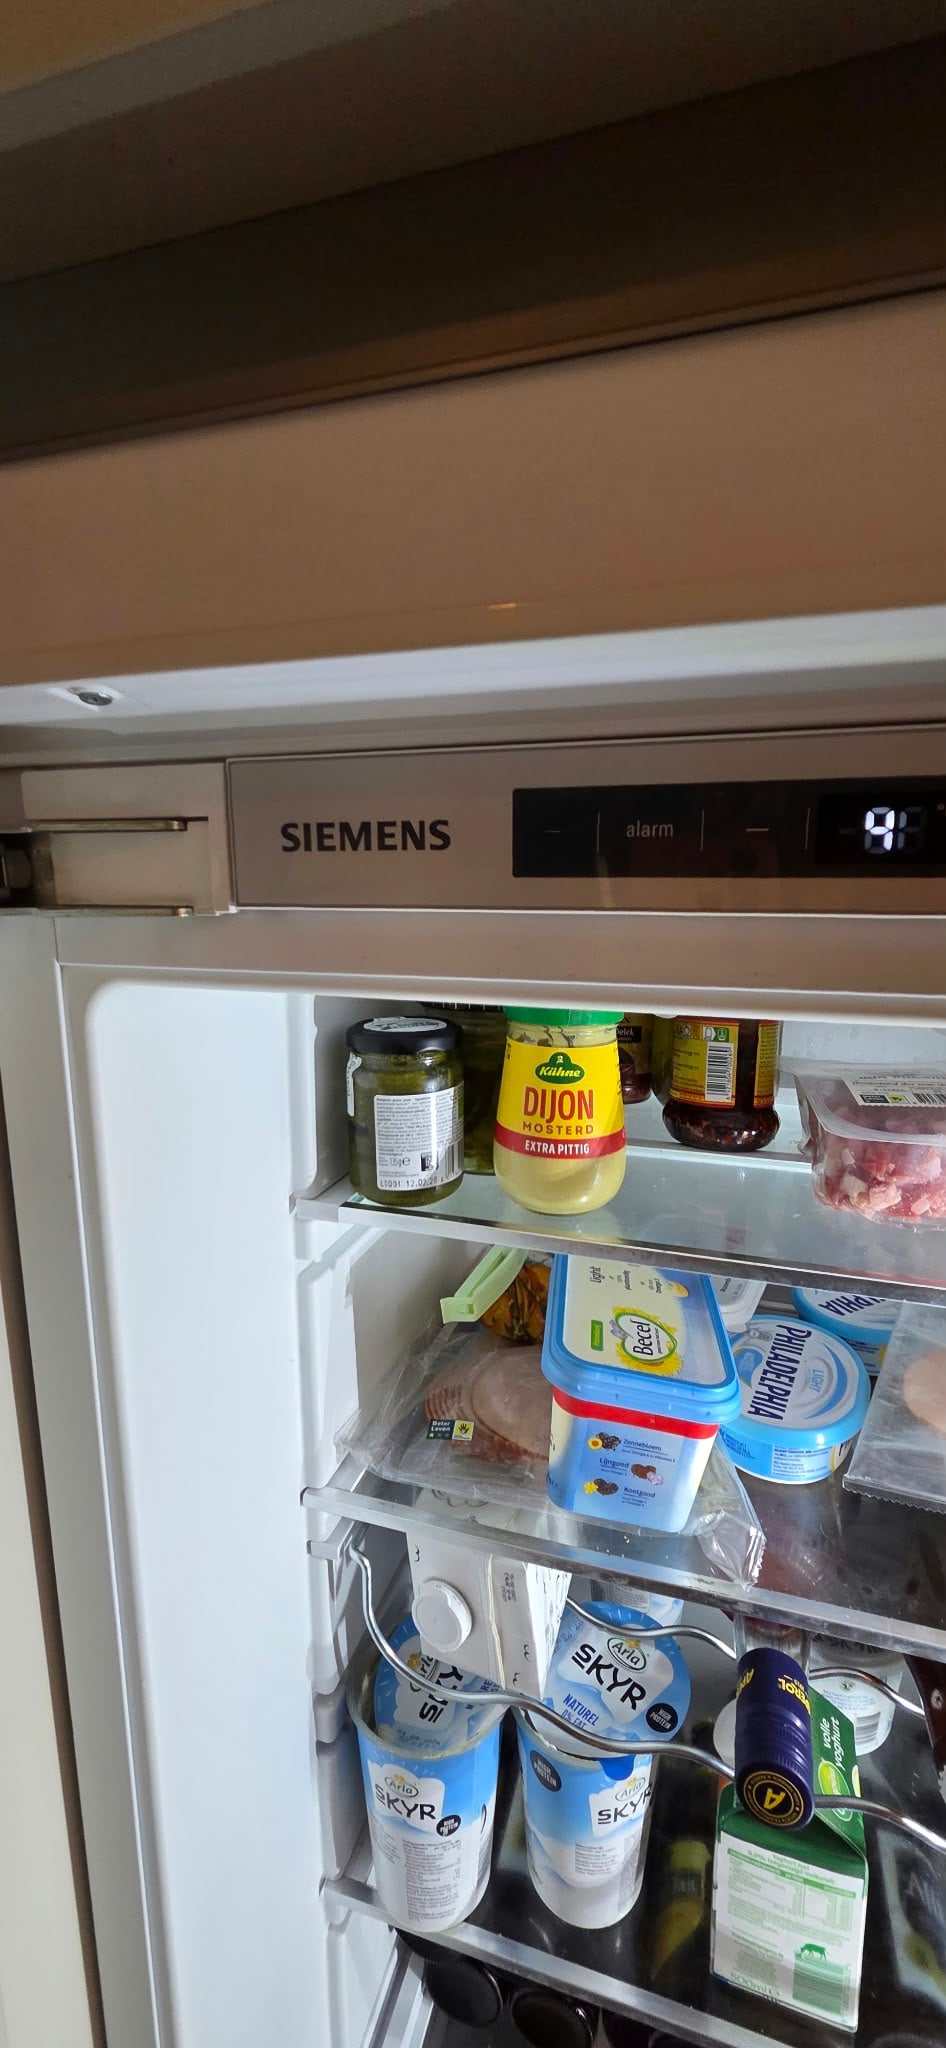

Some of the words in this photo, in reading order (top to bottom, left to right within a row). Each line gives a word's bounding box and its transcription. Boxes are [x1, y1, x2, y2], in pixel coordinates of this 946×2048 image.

[281, 820, 452, 852] SIEMENS
[626, 820, 673, 839] alarm
[864, 809, 895, 850] 4
[539, 1066, 581, 1077] Kühne
[523, 1086, 594, 1124] DIJON
[522, 1120, 594, 1136] MOSTERD
[525, 1139, 556, 1154] EXTRA
[557, 1143, 590, 1155] PITTIG
[589, 1265, 606, 1284] Light
[818, 1295, 886, 1317] PHIA
[629, 1316, 654, 1356] Becel
[747, 1325, 812, 1421] PHILADELPHIA
[809, 1369, 825, 1393] LIGHT
[611, 1641, 641, 1666] Arla
[571, 1643, 647, 1711] SKYR
[562, 1693, 600, 1726] NATUREL
[820, 1717, 832, 1749] volle
[830, 1716, 846, 1771] yoghurt
[374, 1783, 437, 1820] SKYR
[389, 1781, 413, 1795] Arla
[763, 1787, 786, 1810] A
